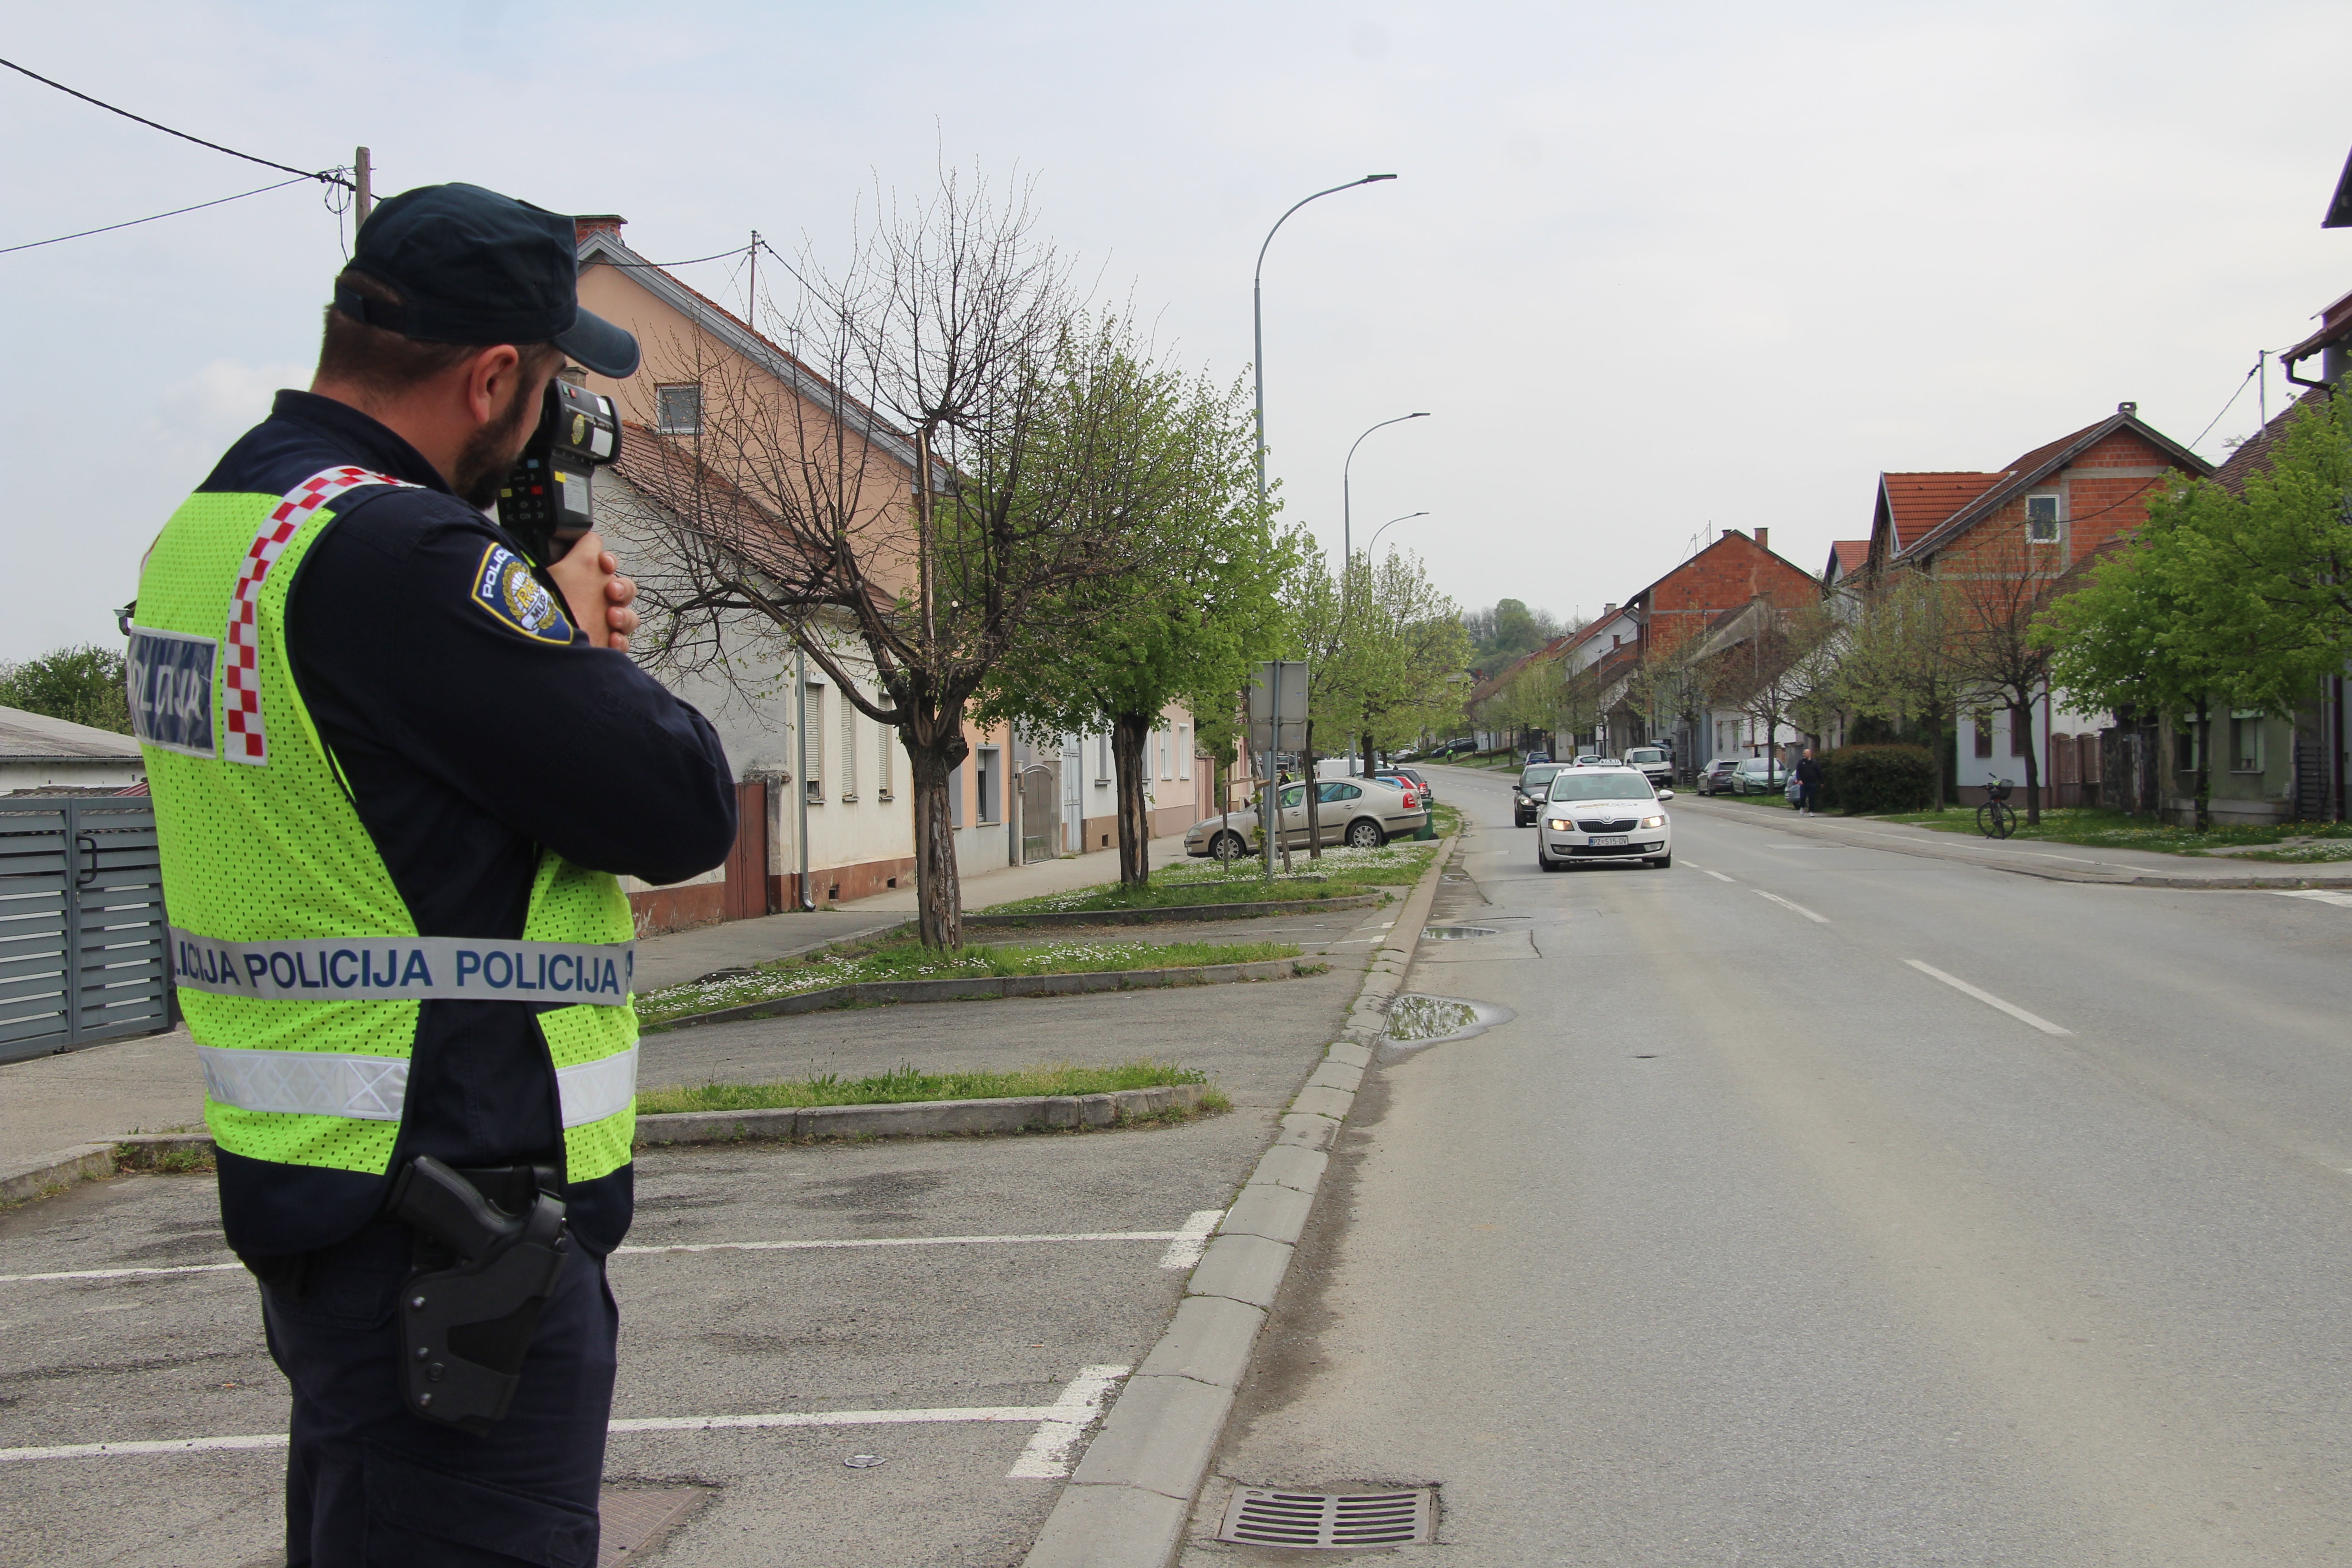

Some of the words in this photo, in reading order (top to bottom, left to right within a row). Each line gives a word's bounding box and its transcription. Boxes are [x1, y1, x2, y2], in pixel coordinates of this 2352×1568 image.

[530, 594, 547, 621] MUP
[243, 949, 433, 989] POLICIJA
[456, 951, 620, 995] POLICIJA
